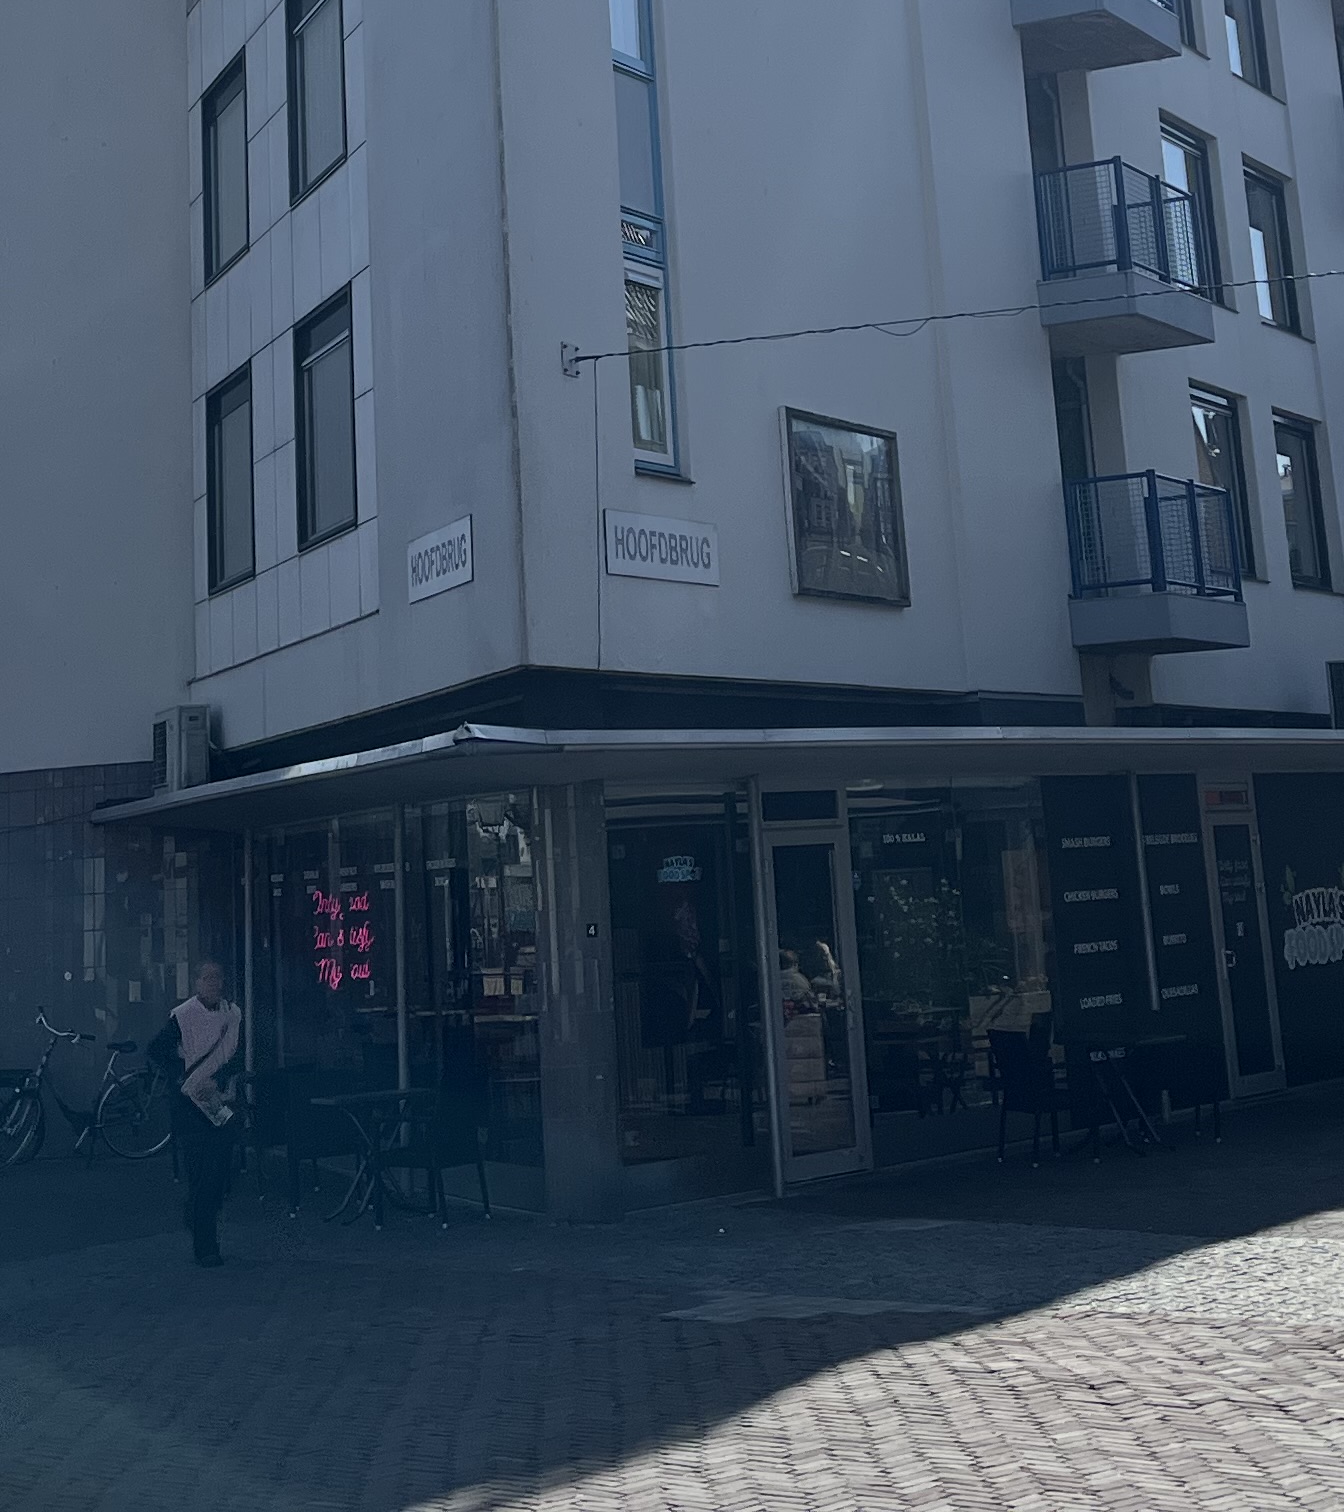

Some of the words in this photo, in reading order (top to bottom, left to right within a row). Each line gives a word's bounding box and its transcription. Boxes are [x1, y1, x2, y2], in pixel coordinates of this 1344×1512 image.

[410, 534, 467, 588] HOOFDBRUG
[614, 525, 712, 570] HOOFDBRUG
[589, 925, 595, 936] 4
